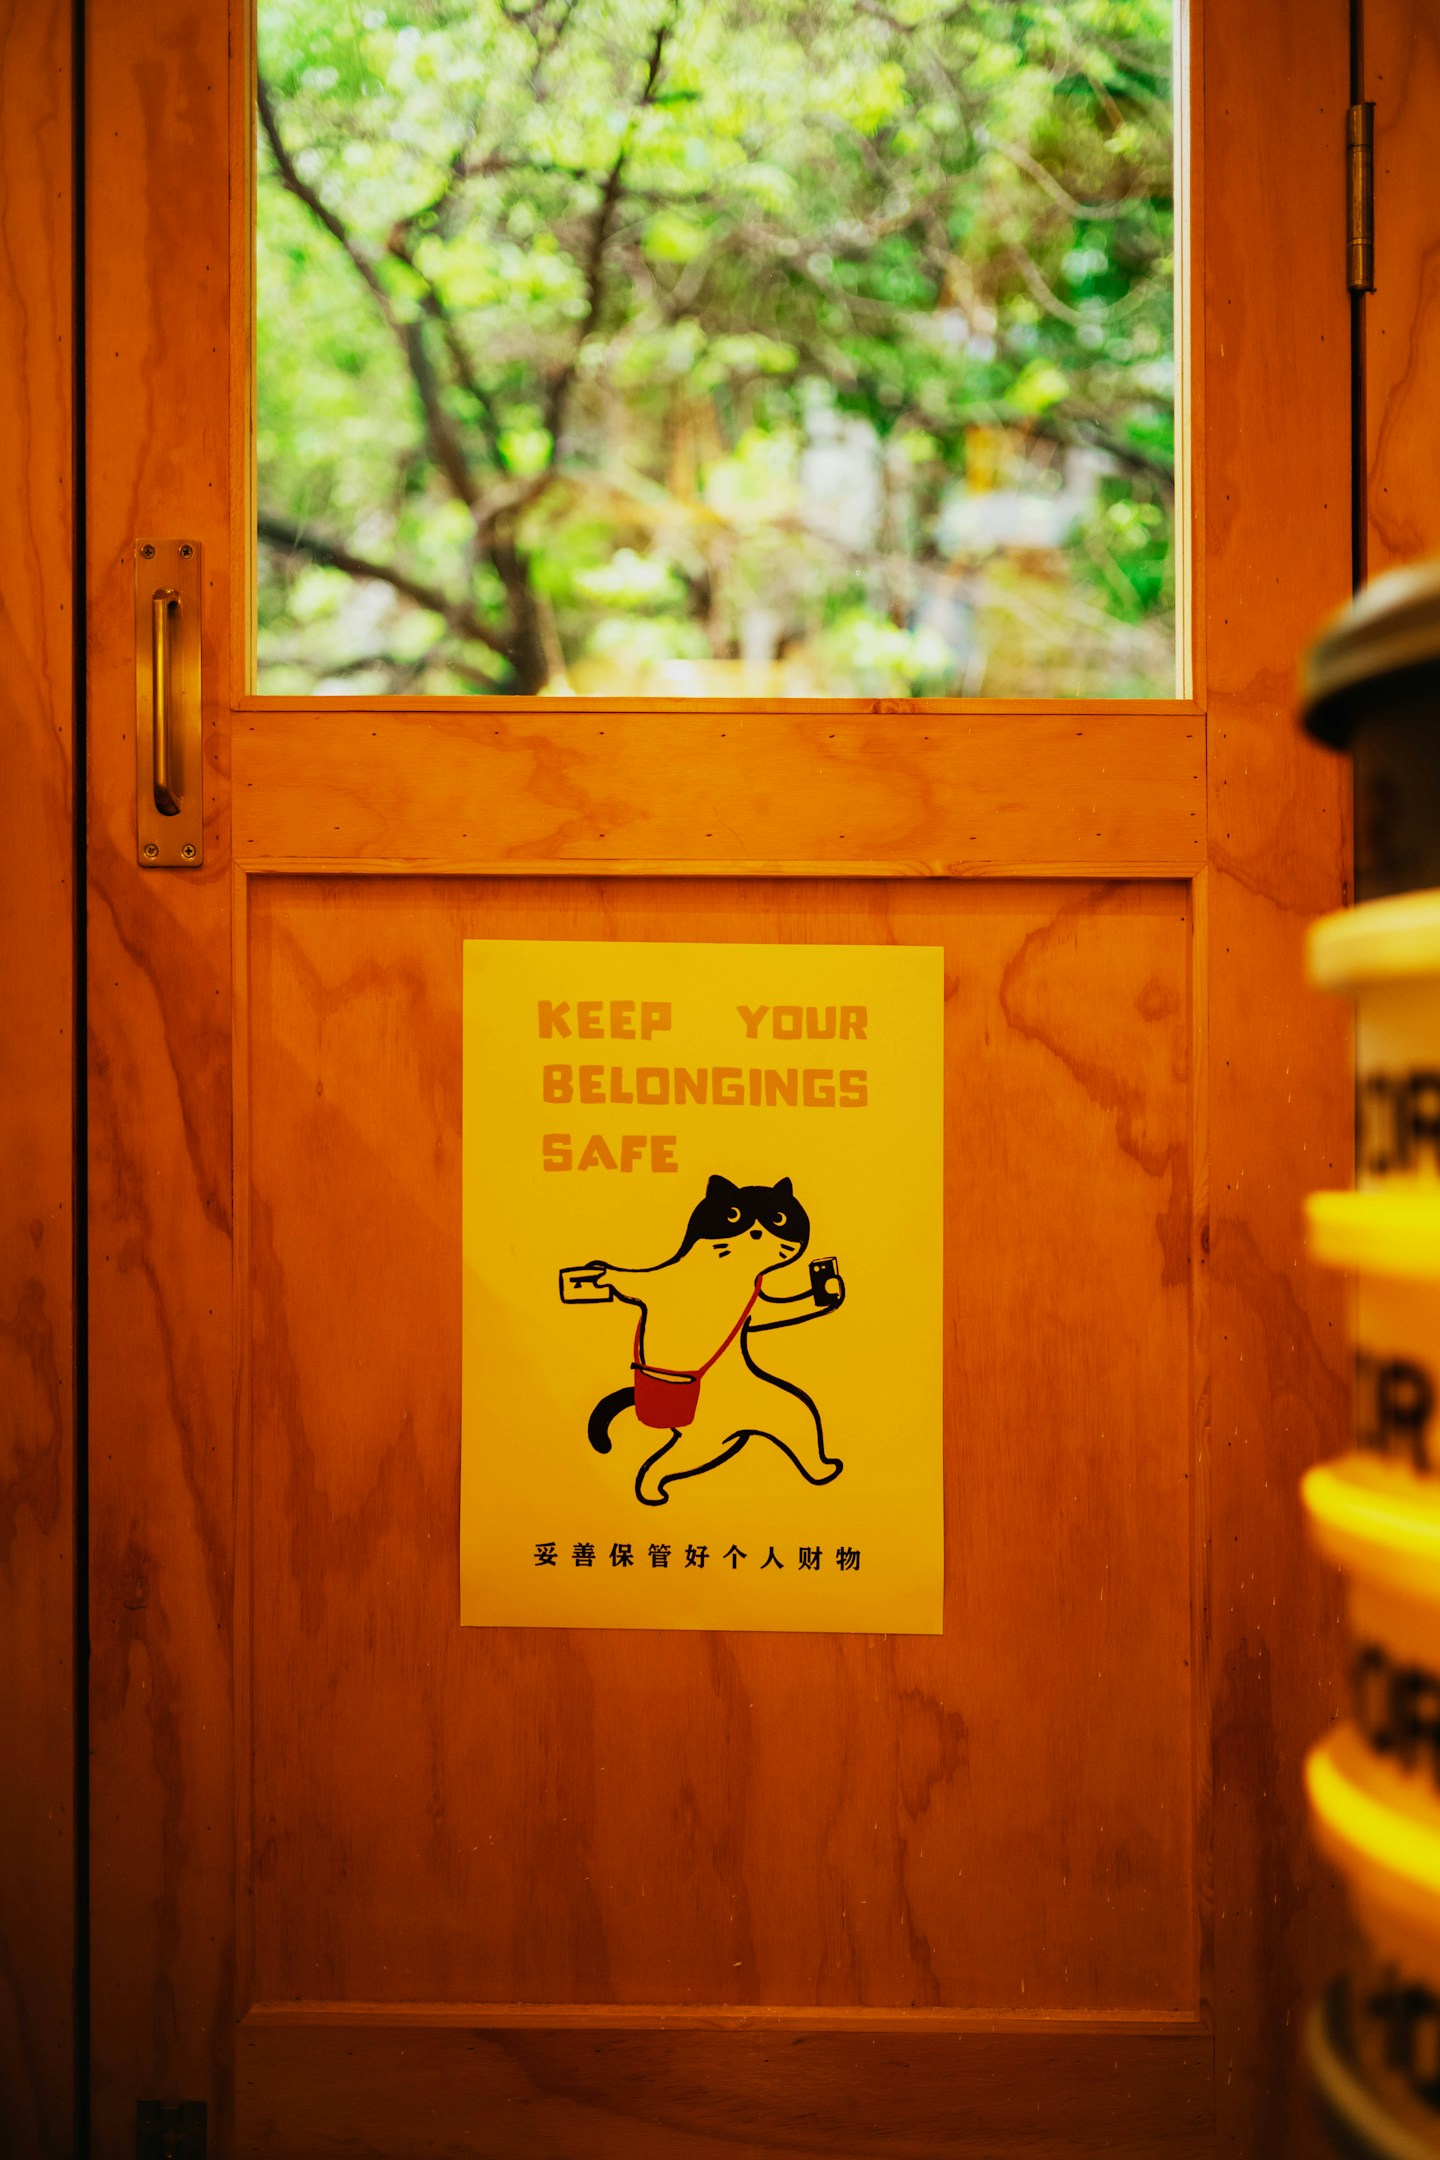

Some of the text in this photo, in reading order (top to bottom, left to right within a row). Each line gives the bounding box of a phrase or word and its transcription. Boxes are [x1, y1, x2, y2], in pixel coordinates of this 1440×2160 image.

[537, 1000, 868, 1041] KEEP YOUR
[543, 1064, 868, 1108] BELONGINGS
[543, 1133, 679, 1173] SAFE
[533, 1540, 862, 1572] 妥善保管好个人财物
